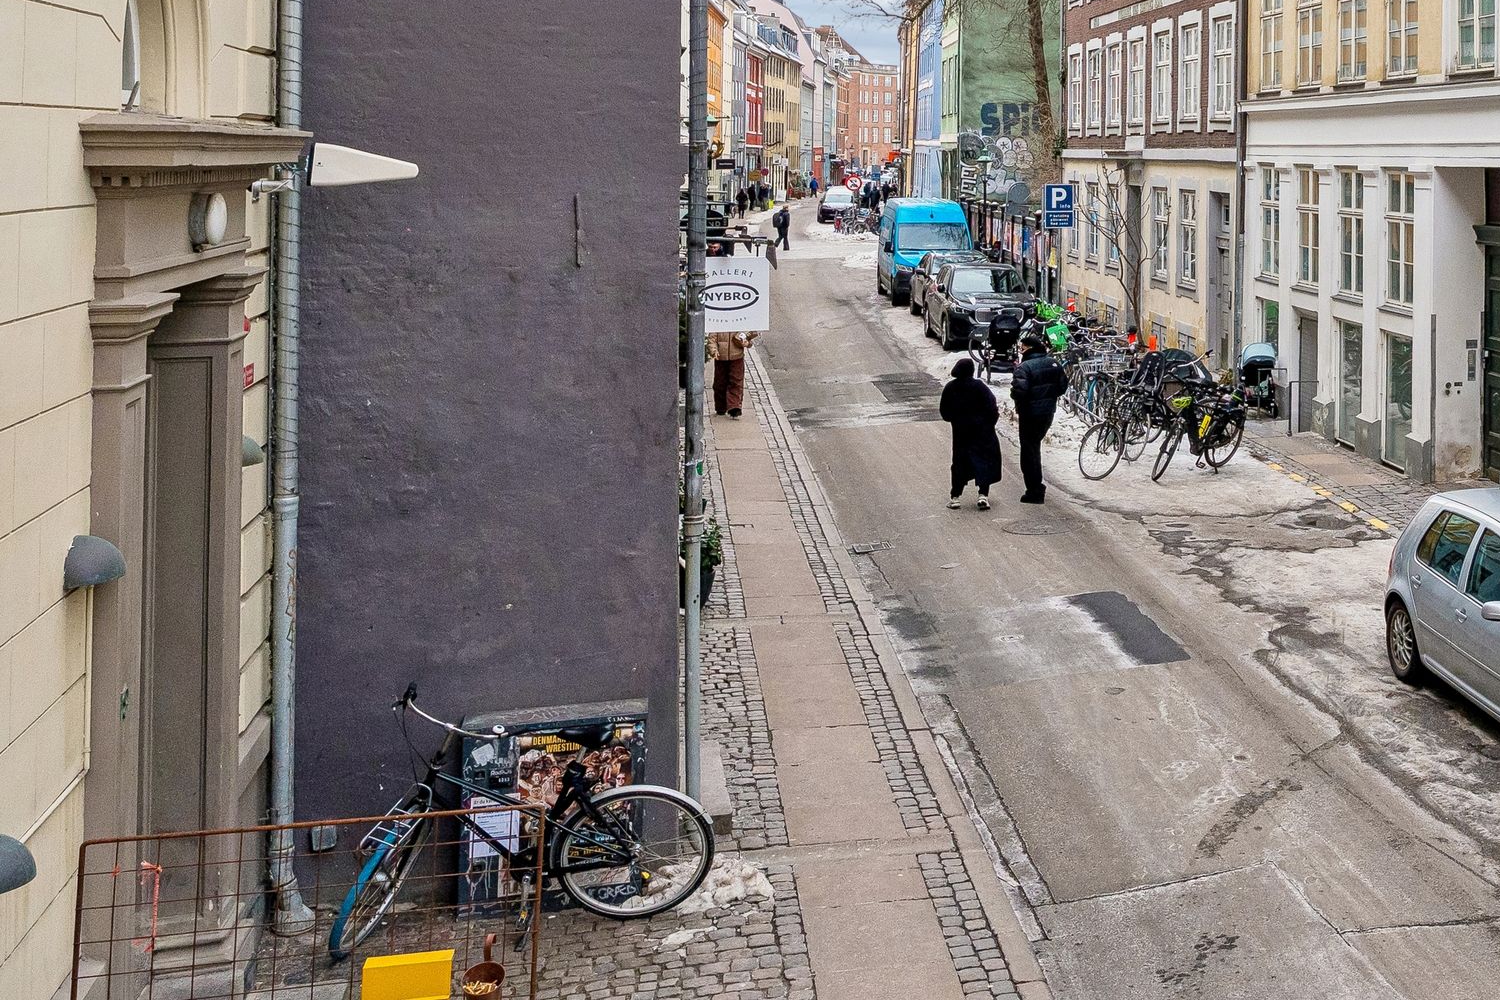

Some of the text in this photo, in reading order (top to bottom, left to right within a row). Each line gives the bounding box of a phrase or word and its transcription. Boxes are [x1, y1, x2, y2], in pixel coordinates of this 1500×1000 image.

[1051, 187, 1067, 208] P
[705, 268, 753, 278] GALLERI
[704, 291, 751, 301] NYBRO
